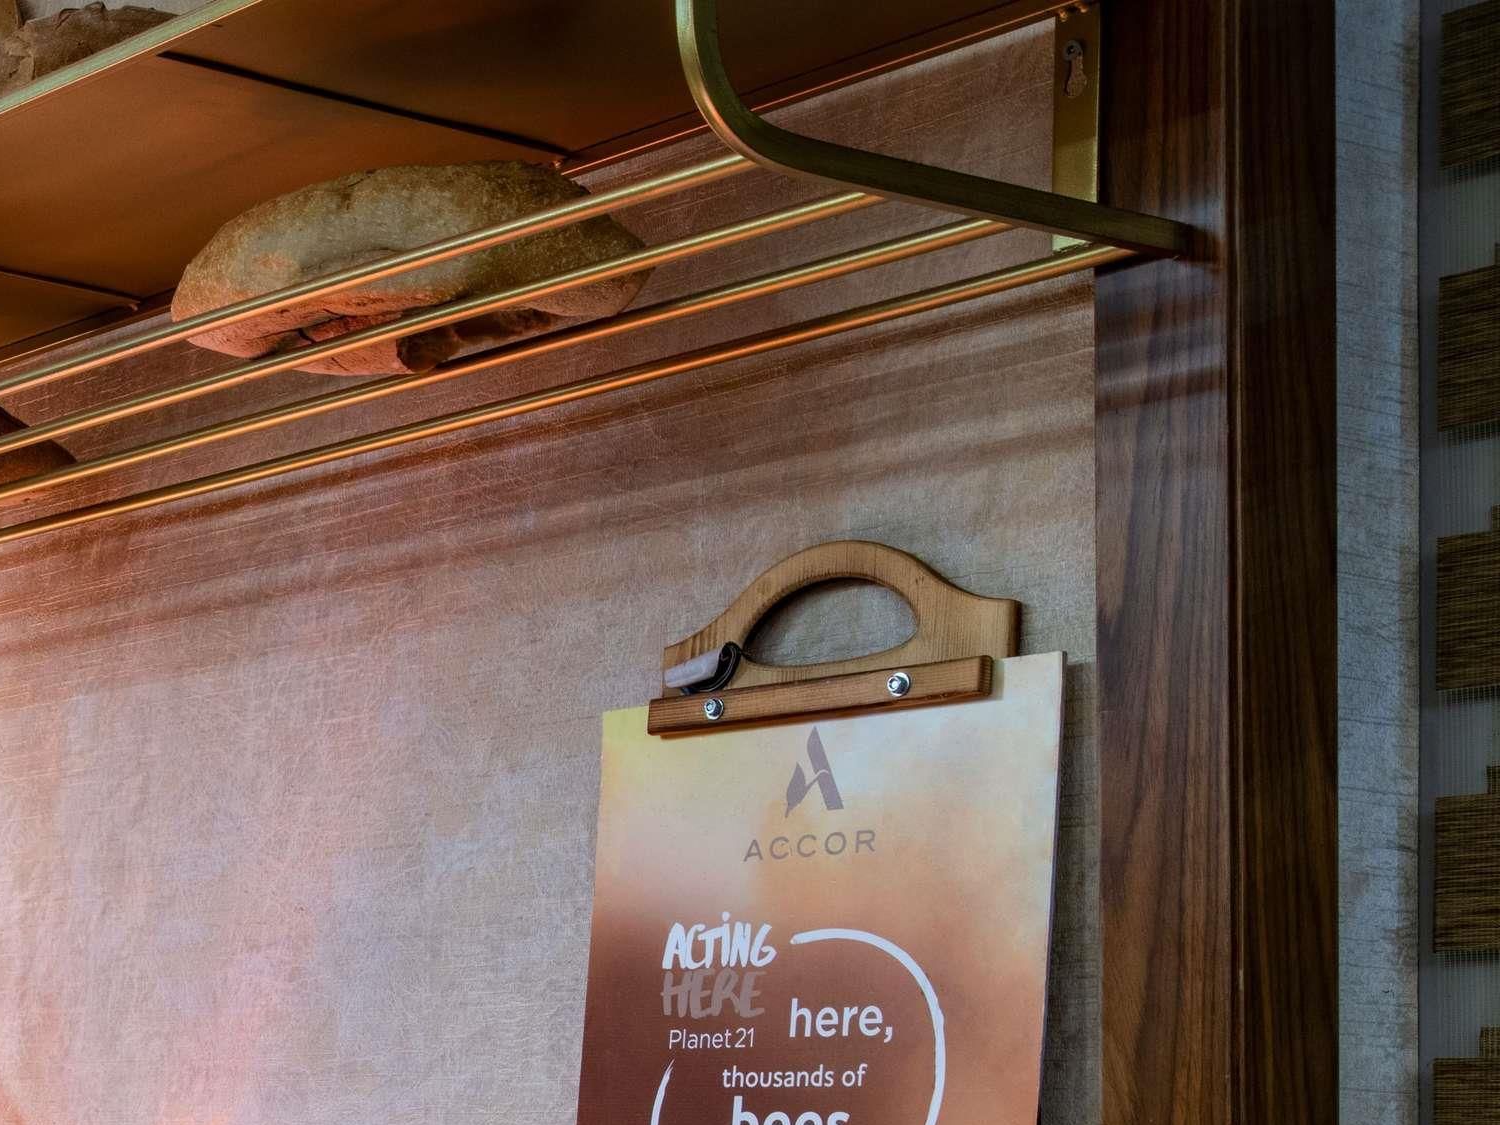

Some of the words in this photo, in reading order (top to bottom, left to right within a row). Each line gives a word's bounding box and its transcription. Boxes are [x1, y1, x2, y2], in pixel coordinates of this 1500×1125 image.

[743, 829, 877, 862] ACCOR
[661, 911, 777, 969] ACTING
[660, 968, 765, 1018] HERE
[668, 1028, 732, 1049] Planet
[734, 1027, 755, 1048] 21
[788, 998, 894, 1043] here,
[721, 1064, 835, 1088] thousands
[842, 1064, 868, 1087] of
